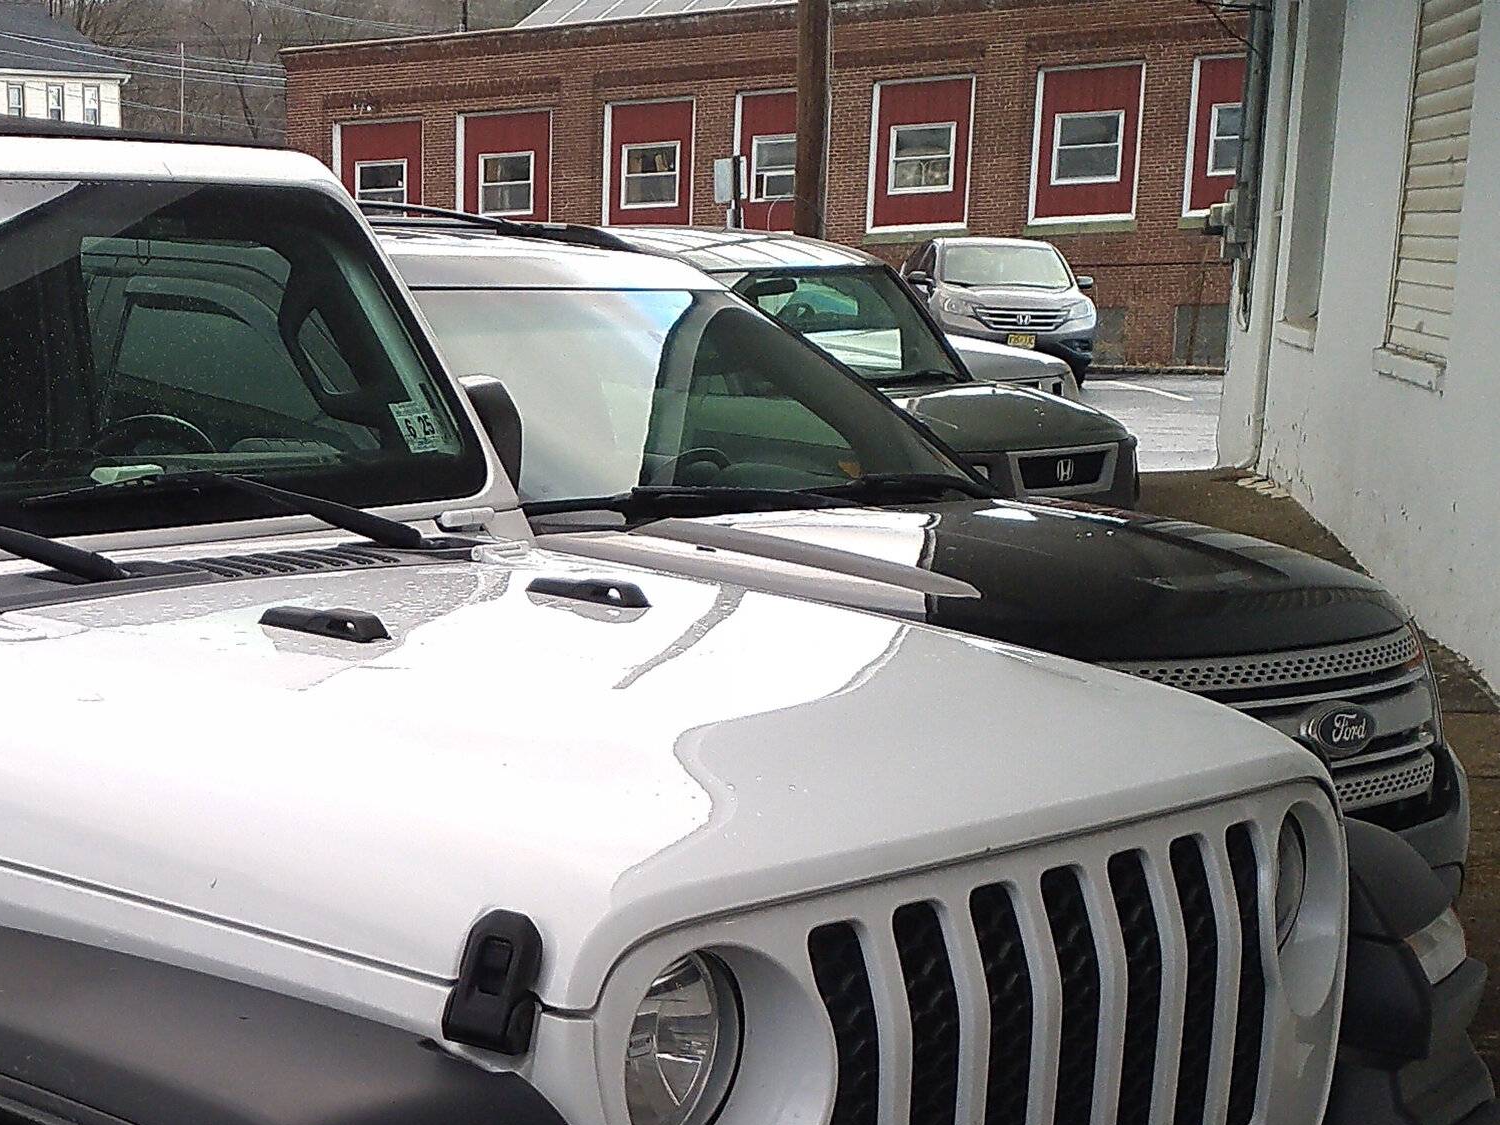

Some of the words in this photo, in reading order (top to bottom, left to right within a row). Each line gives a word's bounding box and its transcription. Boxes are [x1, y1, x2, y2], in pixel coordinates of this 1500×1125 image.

[404, 418, 417, 439] 6
[417, 414, 436, 435] 25
[1332, 713, 1367, 742] Ford
